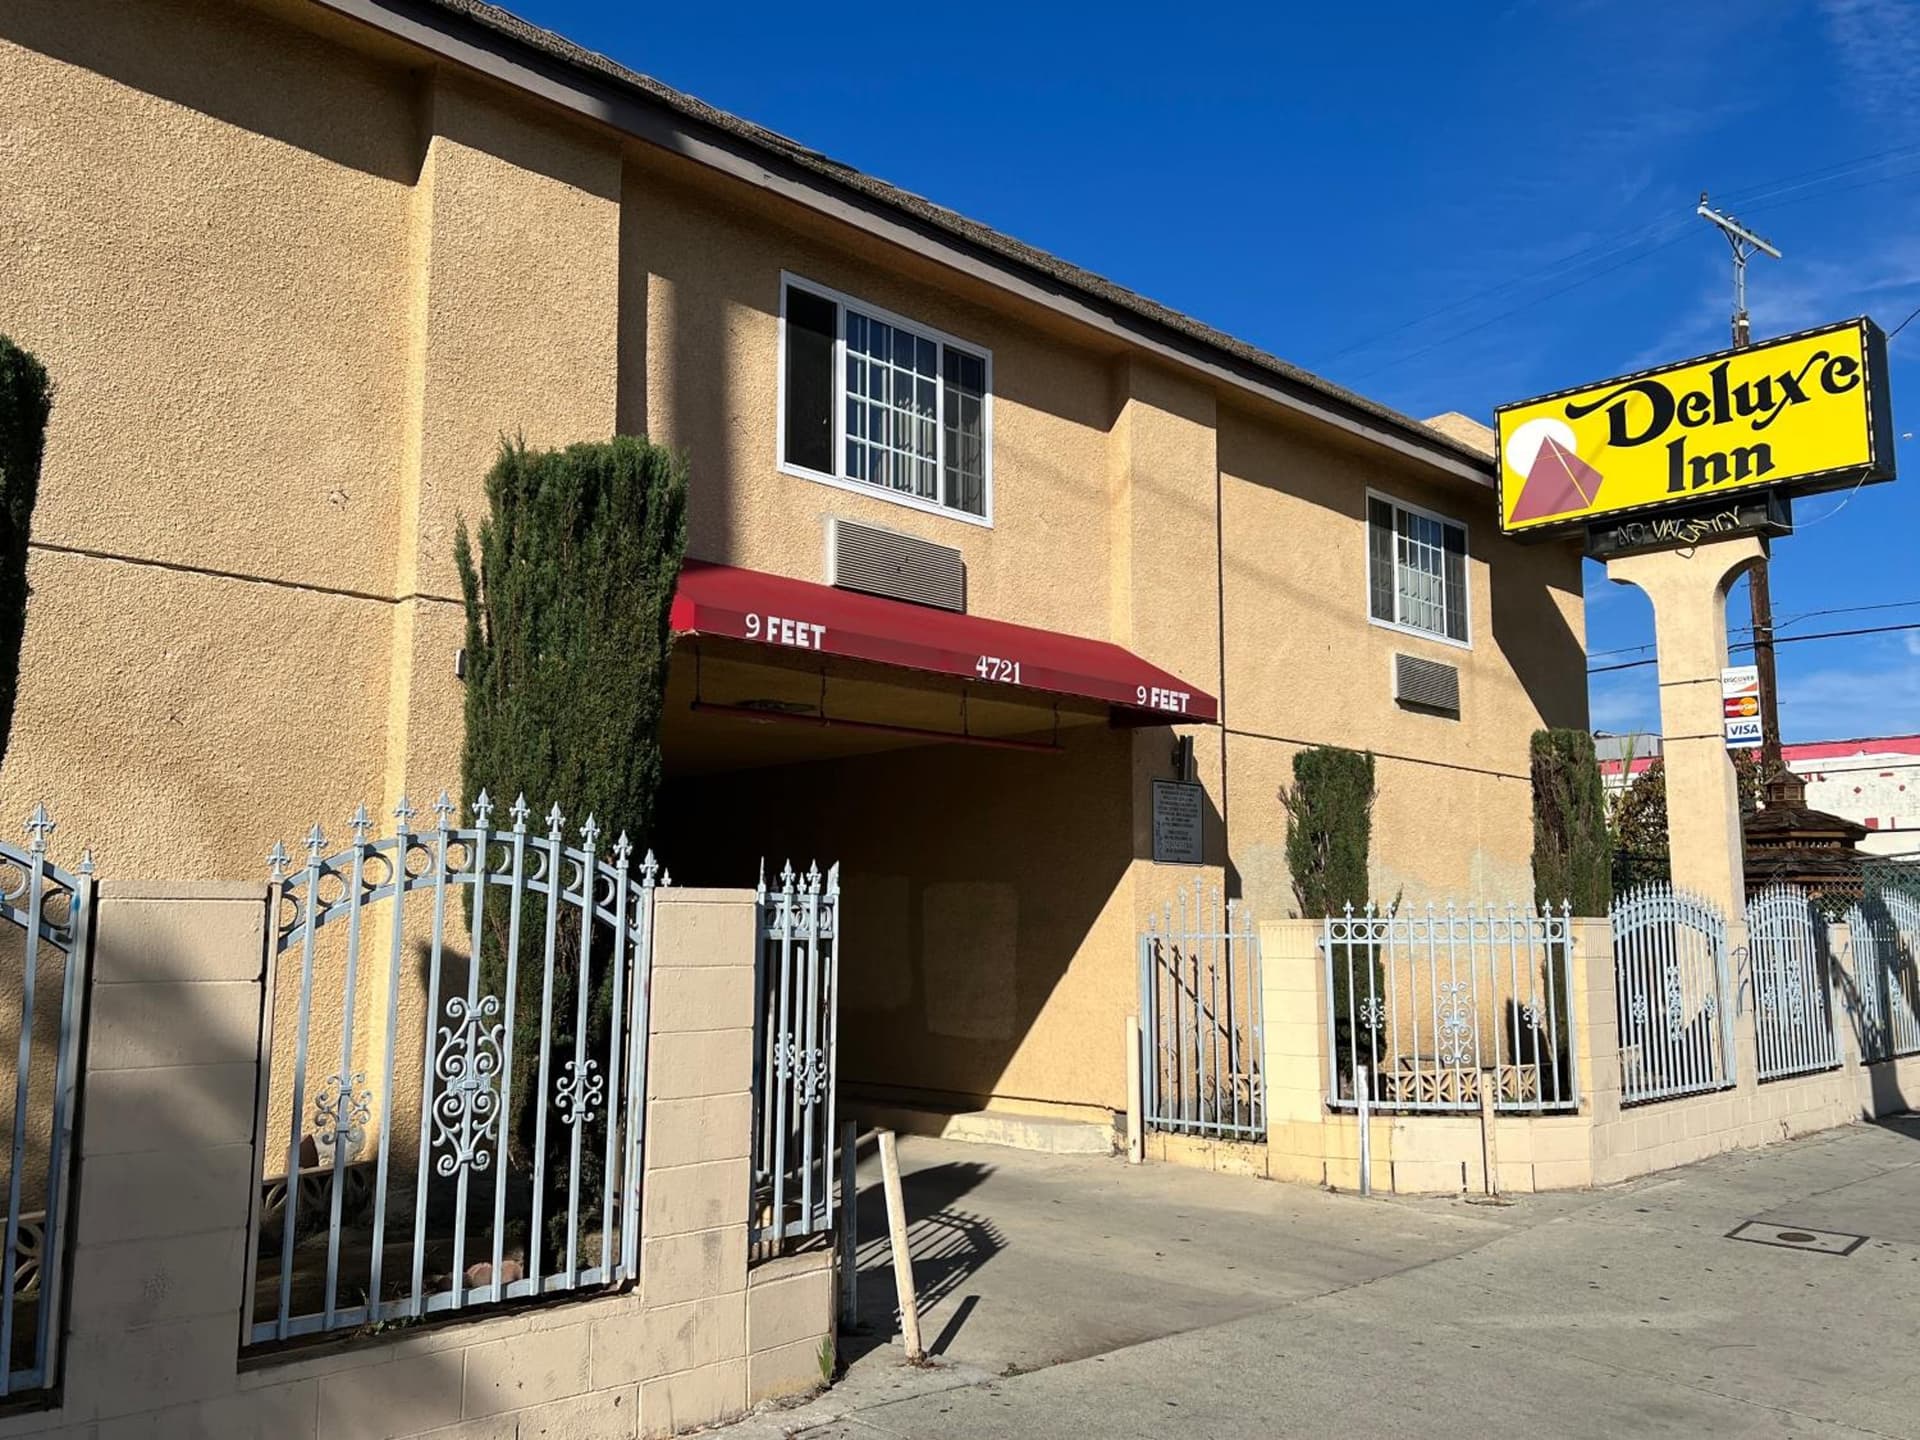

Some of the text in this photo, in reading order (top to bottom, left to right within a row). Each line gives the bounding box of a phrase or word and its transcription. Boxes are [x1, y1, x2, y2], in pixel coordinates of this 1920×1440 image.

[1565, 351, 1860, 448] Deluxe
[1666, 436, 1776, 493] Inn
[745, 612, 826, 650] 9 FEET
[975, 655, 1021, 684] 4721
[1136, 685, 1190, 713] 9 FEET
[1730, 724, 1759, 735] VISA
